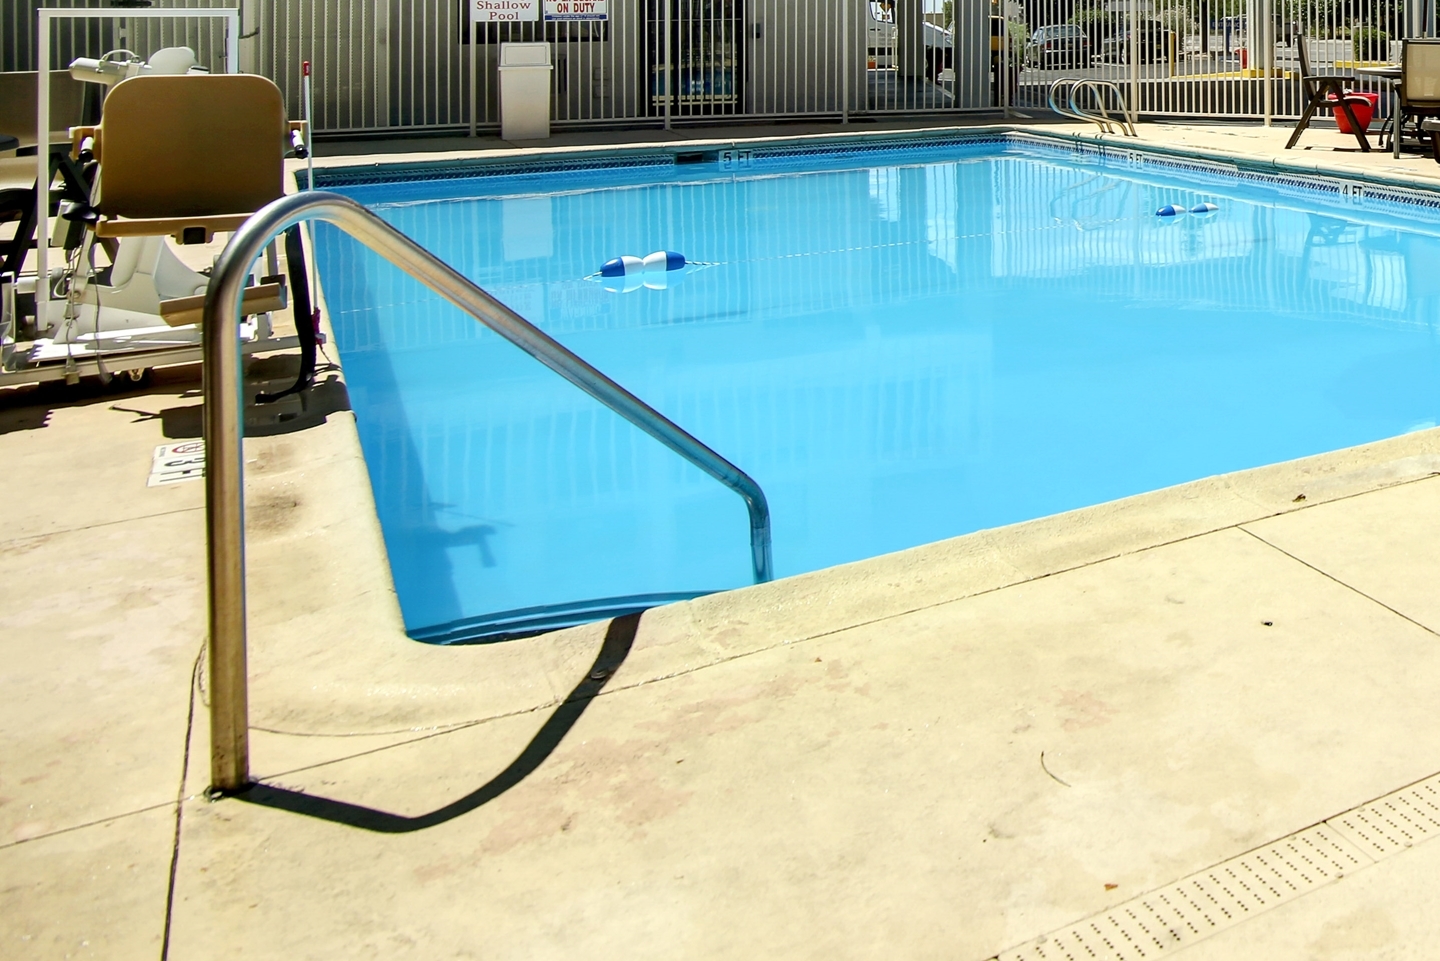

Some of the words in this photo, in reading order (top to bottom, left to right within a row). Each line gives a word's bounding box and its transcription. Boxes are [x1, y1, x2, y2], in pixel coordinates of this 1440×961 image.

[476, 0, 531, 10] Shallow
[557, 3, 569, 13] ON
[573, 2, 595, 13] DUTY
[489, 11, 519, 20] Pool
[723, 151, 731, 162] 5
[738, 150, 752, 161] FT
[1342, 184, 1348, 195] 4
[1352, 185, 1362, 196] FT
